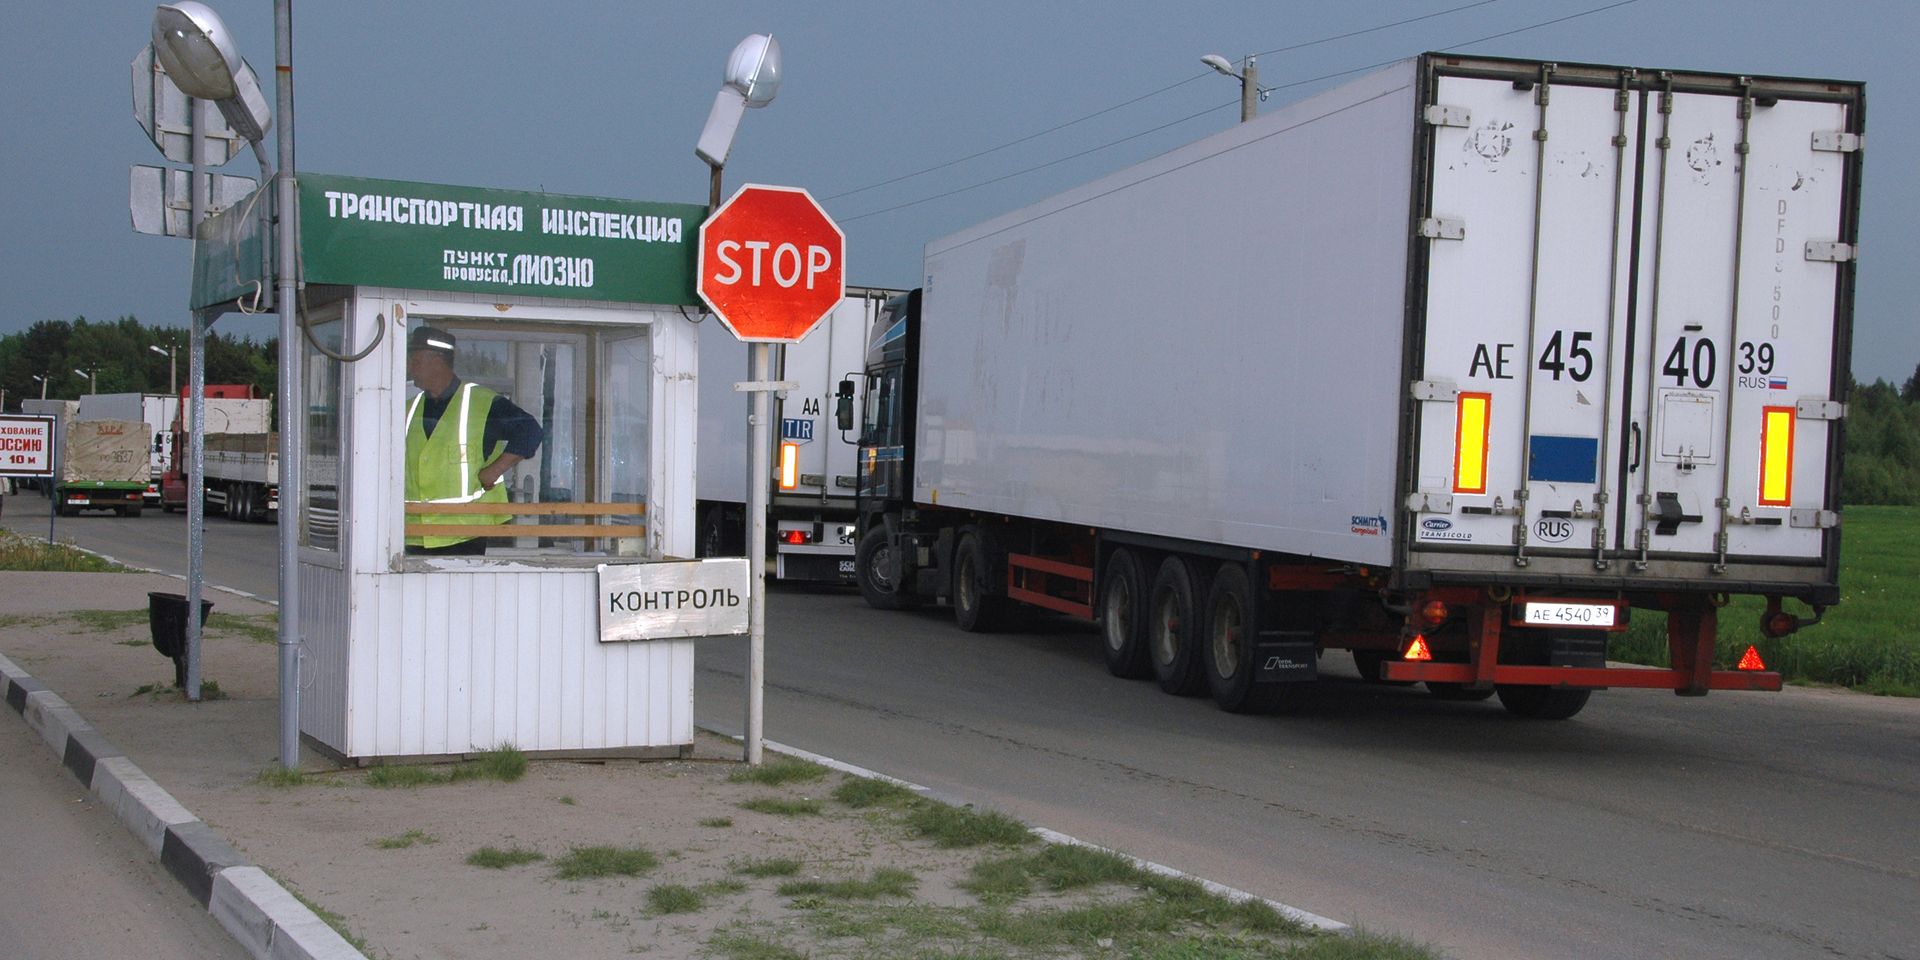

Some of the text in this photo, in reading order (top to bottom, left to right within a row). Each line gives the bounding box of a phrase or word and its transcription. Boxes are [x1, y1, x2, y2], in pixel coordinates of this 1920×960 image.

[324, 191, 683, 244] ТРАНСПОРТНАЯ ИНСПЕКЦИЯ
[443, 249, 508, 267] ПУНКТ
[713, 240, 832, 290] STOP
[1468, 330, 1775, 389] AE 45 40 39
[1738, 376, 1767, 389] RUS
[785, 419, 811, 438] TIR
[9, 455, 24, 464] 10
[1351, 515, 1378, 527] SCHMITZ
[1425, 520, 1449, 529] Carrier
[1537, 520, 1570, 538] RUS
[1421, 530, 1473, 539] TRANSICOLD
[610, 588, 740, 613] КОНТРОЛЬ
[1555, 607, 1592, 622] 4540
[1596, 607, 1610, 618] 39
